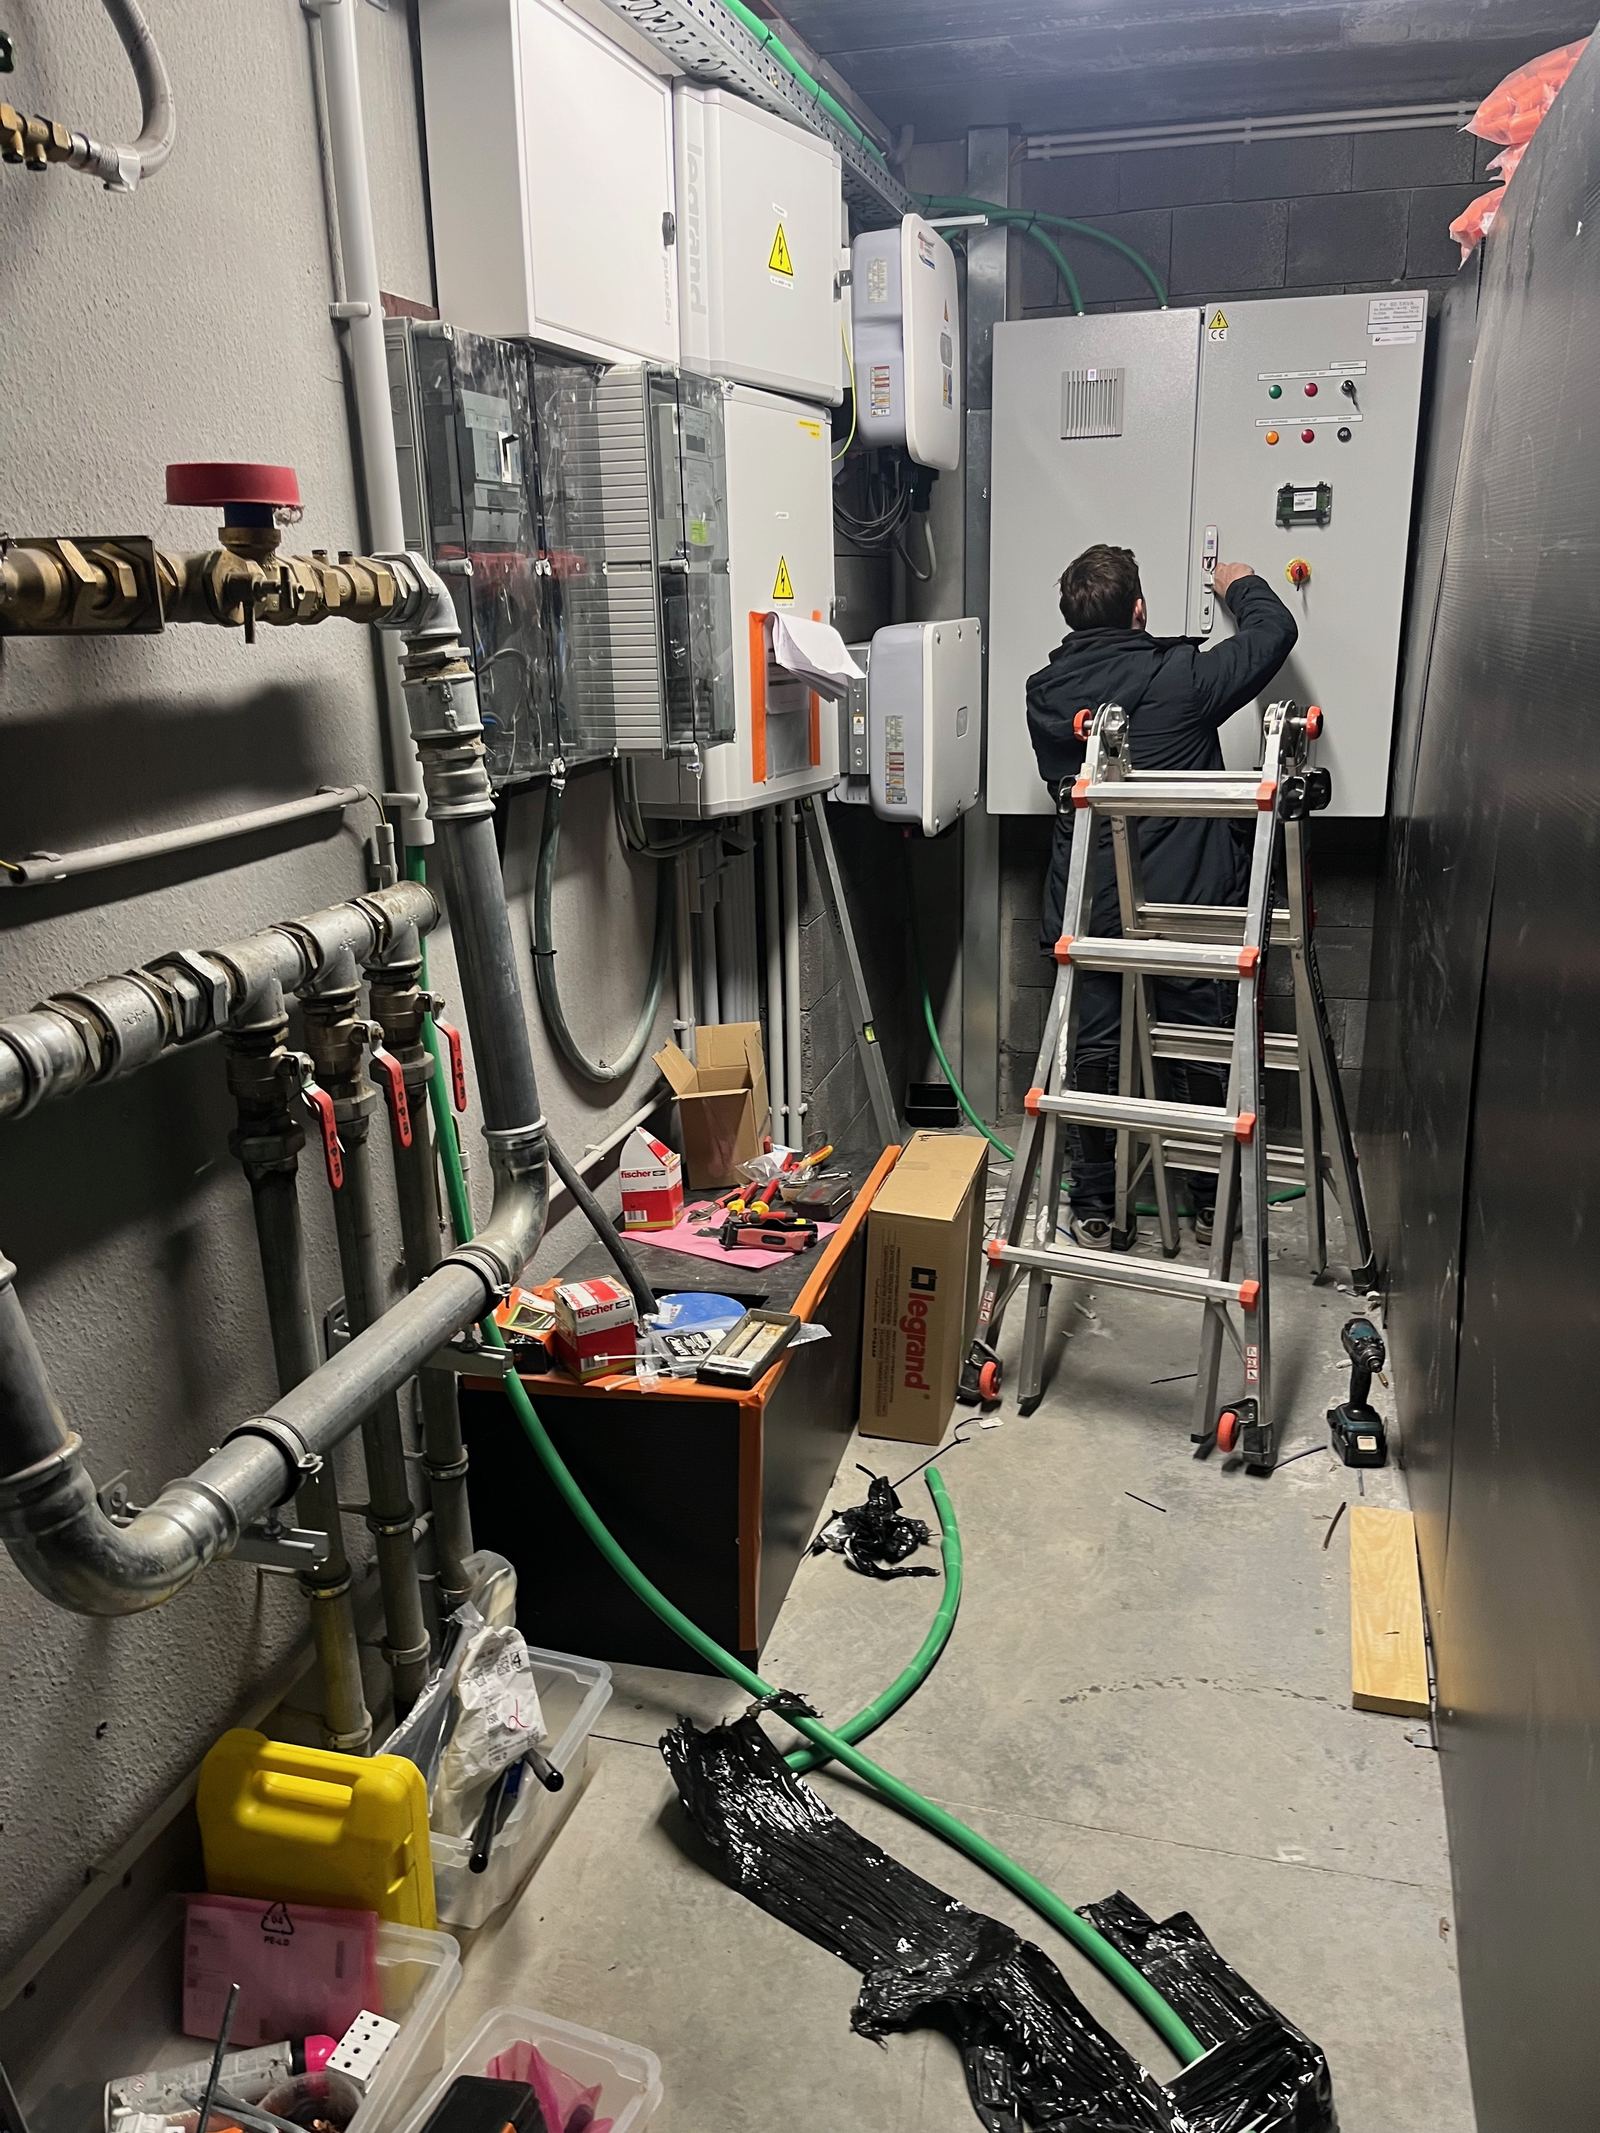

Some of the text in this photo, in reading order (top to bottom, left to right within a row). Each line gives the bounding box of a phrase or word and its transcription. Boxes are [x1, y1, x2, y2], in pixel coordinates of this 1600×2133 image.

[661, 255, 673, 327] legrand
[1211, 329, 1225, 340] CE
[620, 1170, 652, 1179] fischer
[576, 1302, 614, 1319] fischer
[899, 1292, 936, 1391] legrand
